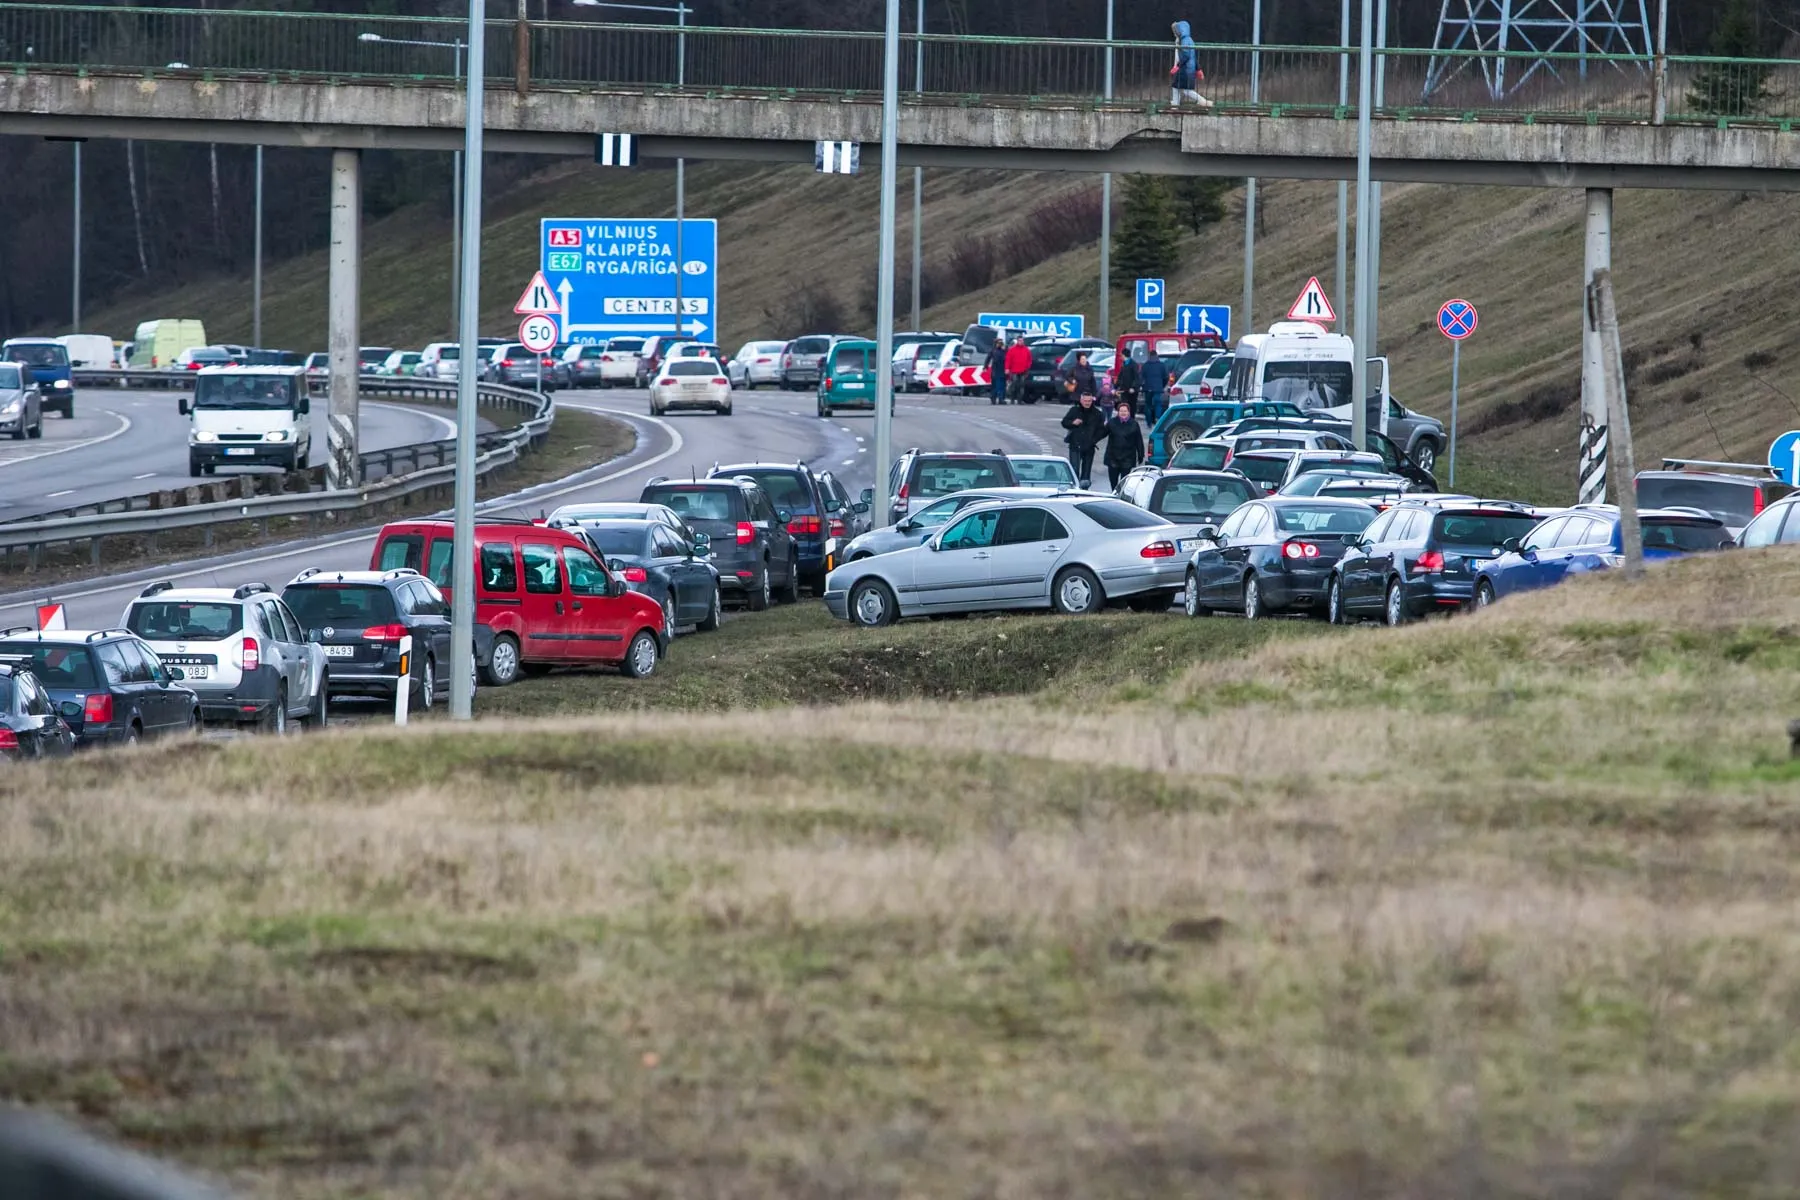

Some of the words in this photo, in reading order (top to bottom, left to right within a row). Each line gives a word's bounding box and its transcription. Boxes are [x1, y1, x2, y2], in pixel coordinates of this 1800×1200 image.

[553, 230, 578, 244] A5
[586, 225, 657, 239] VILNIUS
[586, 240, 672, 256] KLAIPĖDA
[551, 255, 579, 269] E67
[688, 263, 702, 273] LV
[1144, 282, 1160, 304] P
[529, 326, 550, 341] 50
